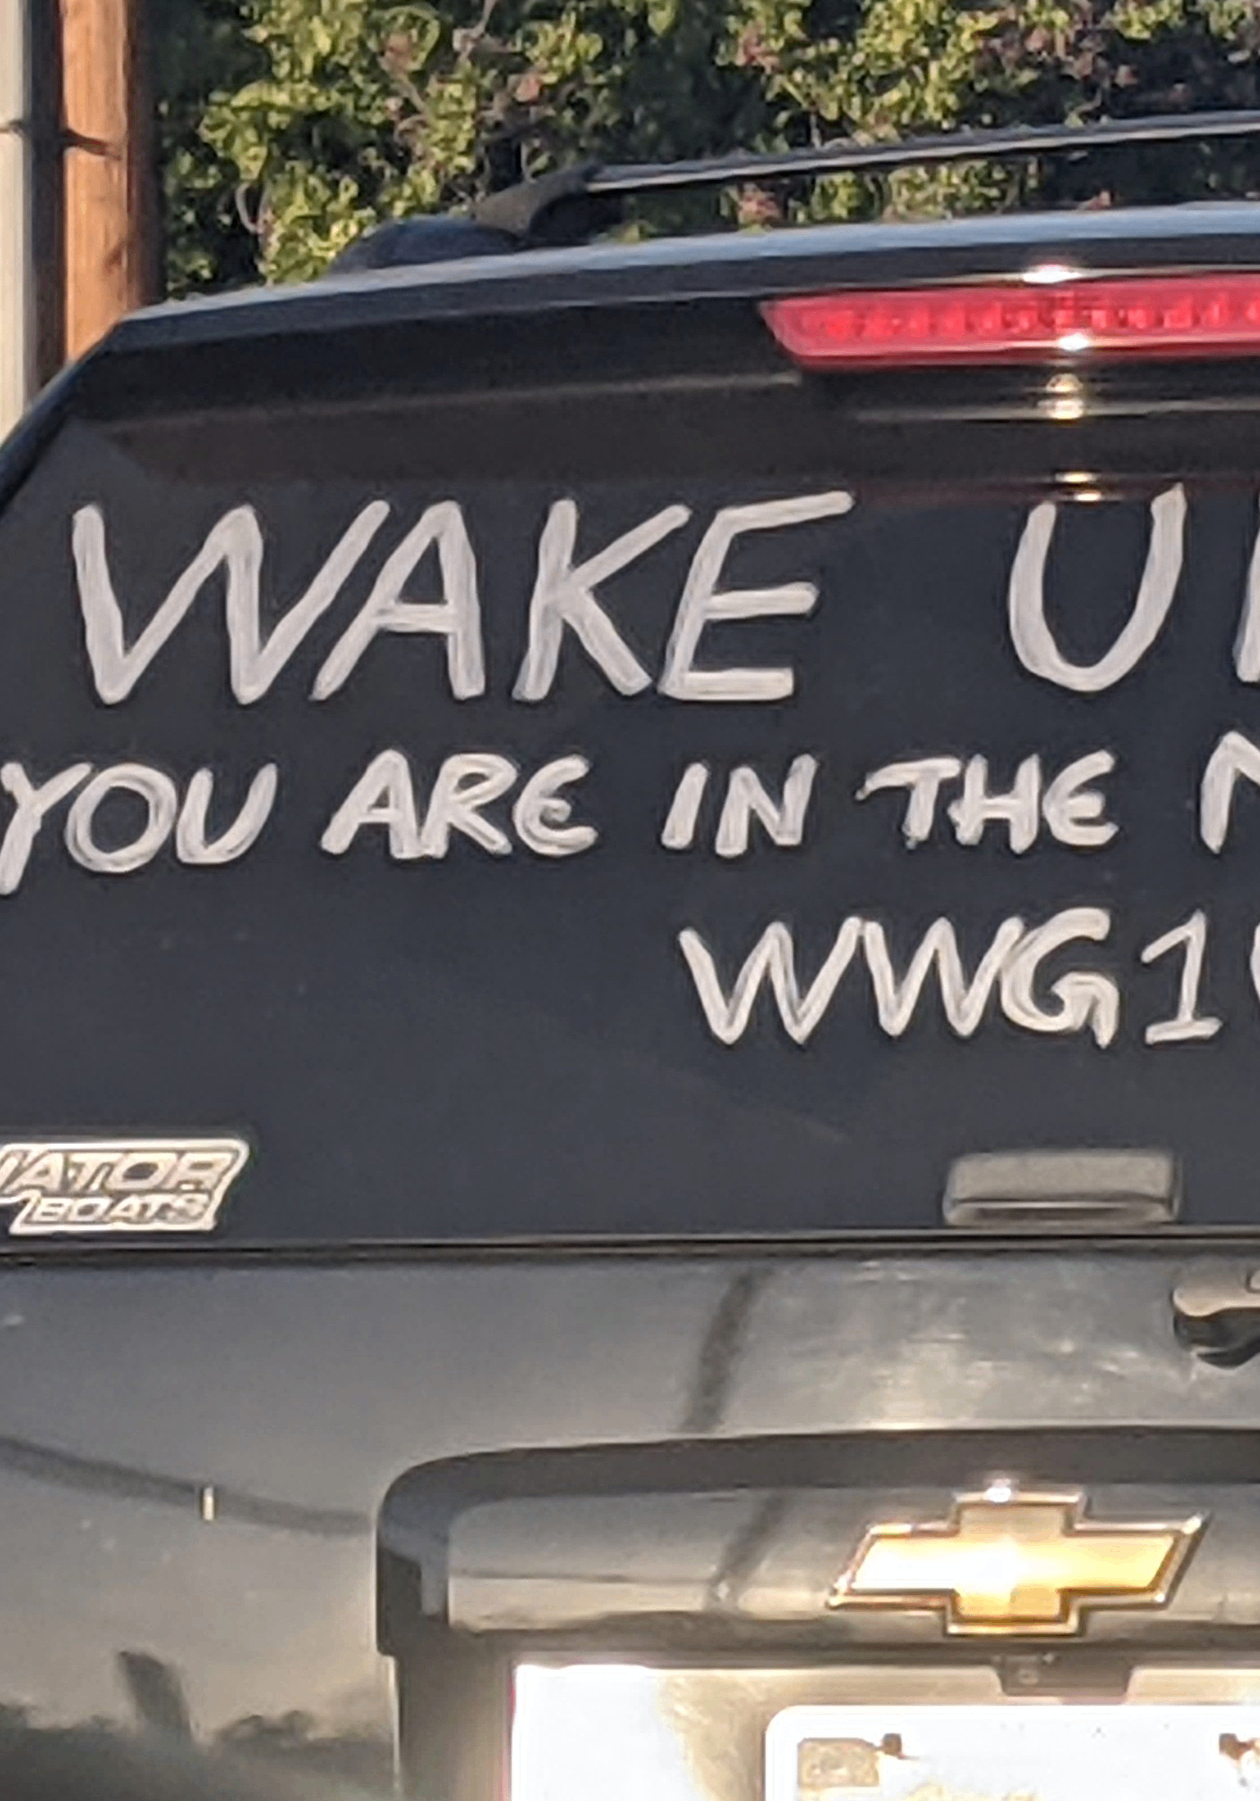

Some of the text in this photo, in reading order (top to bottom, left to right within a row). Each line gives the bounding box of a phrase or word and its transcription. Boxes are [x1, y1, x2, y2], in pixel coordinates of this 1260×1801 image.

[72, 490, 856, 705] WAKE
[0, 762, 278, 892] YOU
[320, 748, 598, 858] ARE
[660, 753, 818, 857] IN
[856, 750, 1118, 853] THE
[32, 1196, 209, 1222] BOATS
